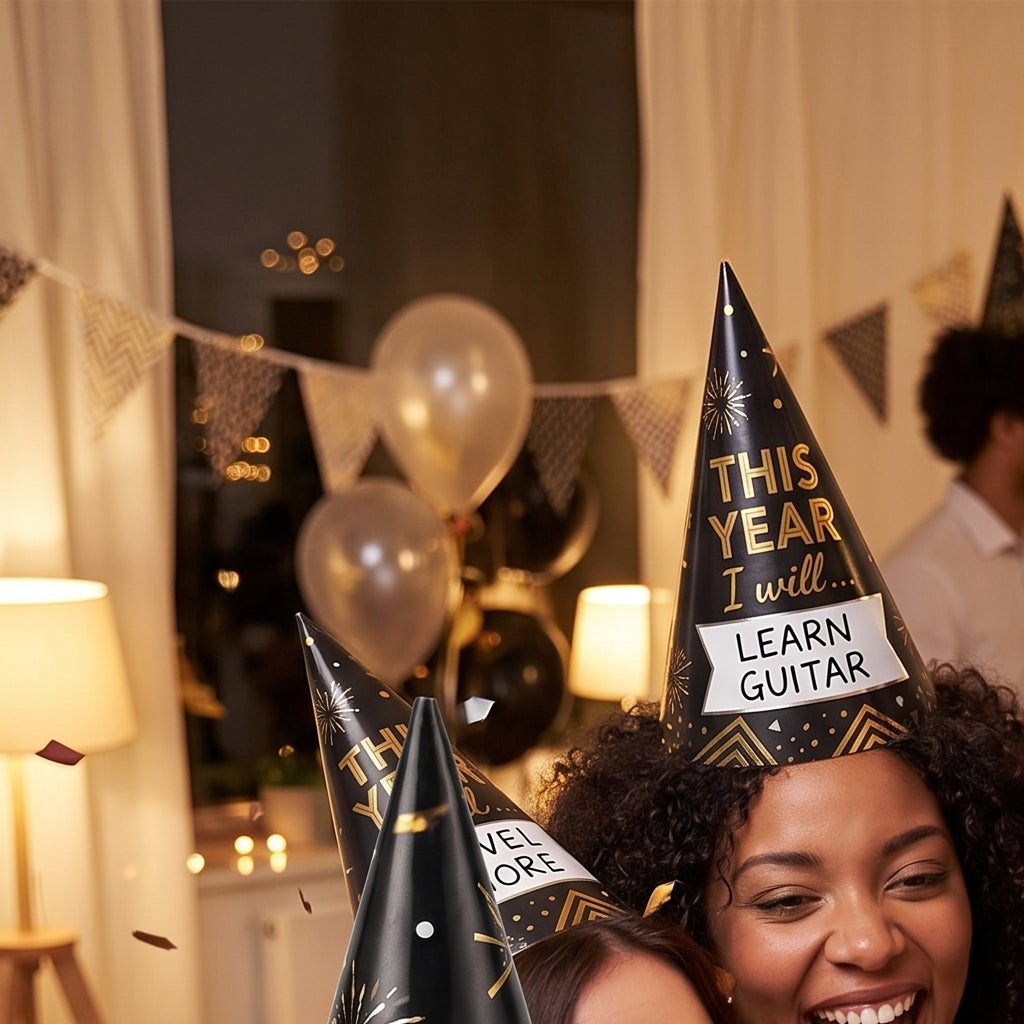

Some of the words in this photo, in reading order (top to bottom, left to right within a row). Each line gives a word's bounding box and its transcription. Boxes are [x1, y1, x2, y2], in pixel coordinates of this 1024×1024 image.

[709, 443, 819, 503] THIS
[708, 497, 842, 560] YEAR
[722, 566, 744, 613] I
[755, 552, 856, 603] will...
[736, 613, 852, 662] LEARN
[740, 651, 870, 702] GUITAR
[338, 724, 408, 786] TH
[480, 827, 543, 855] VEL
[491, 853, 566, 891] ORE
